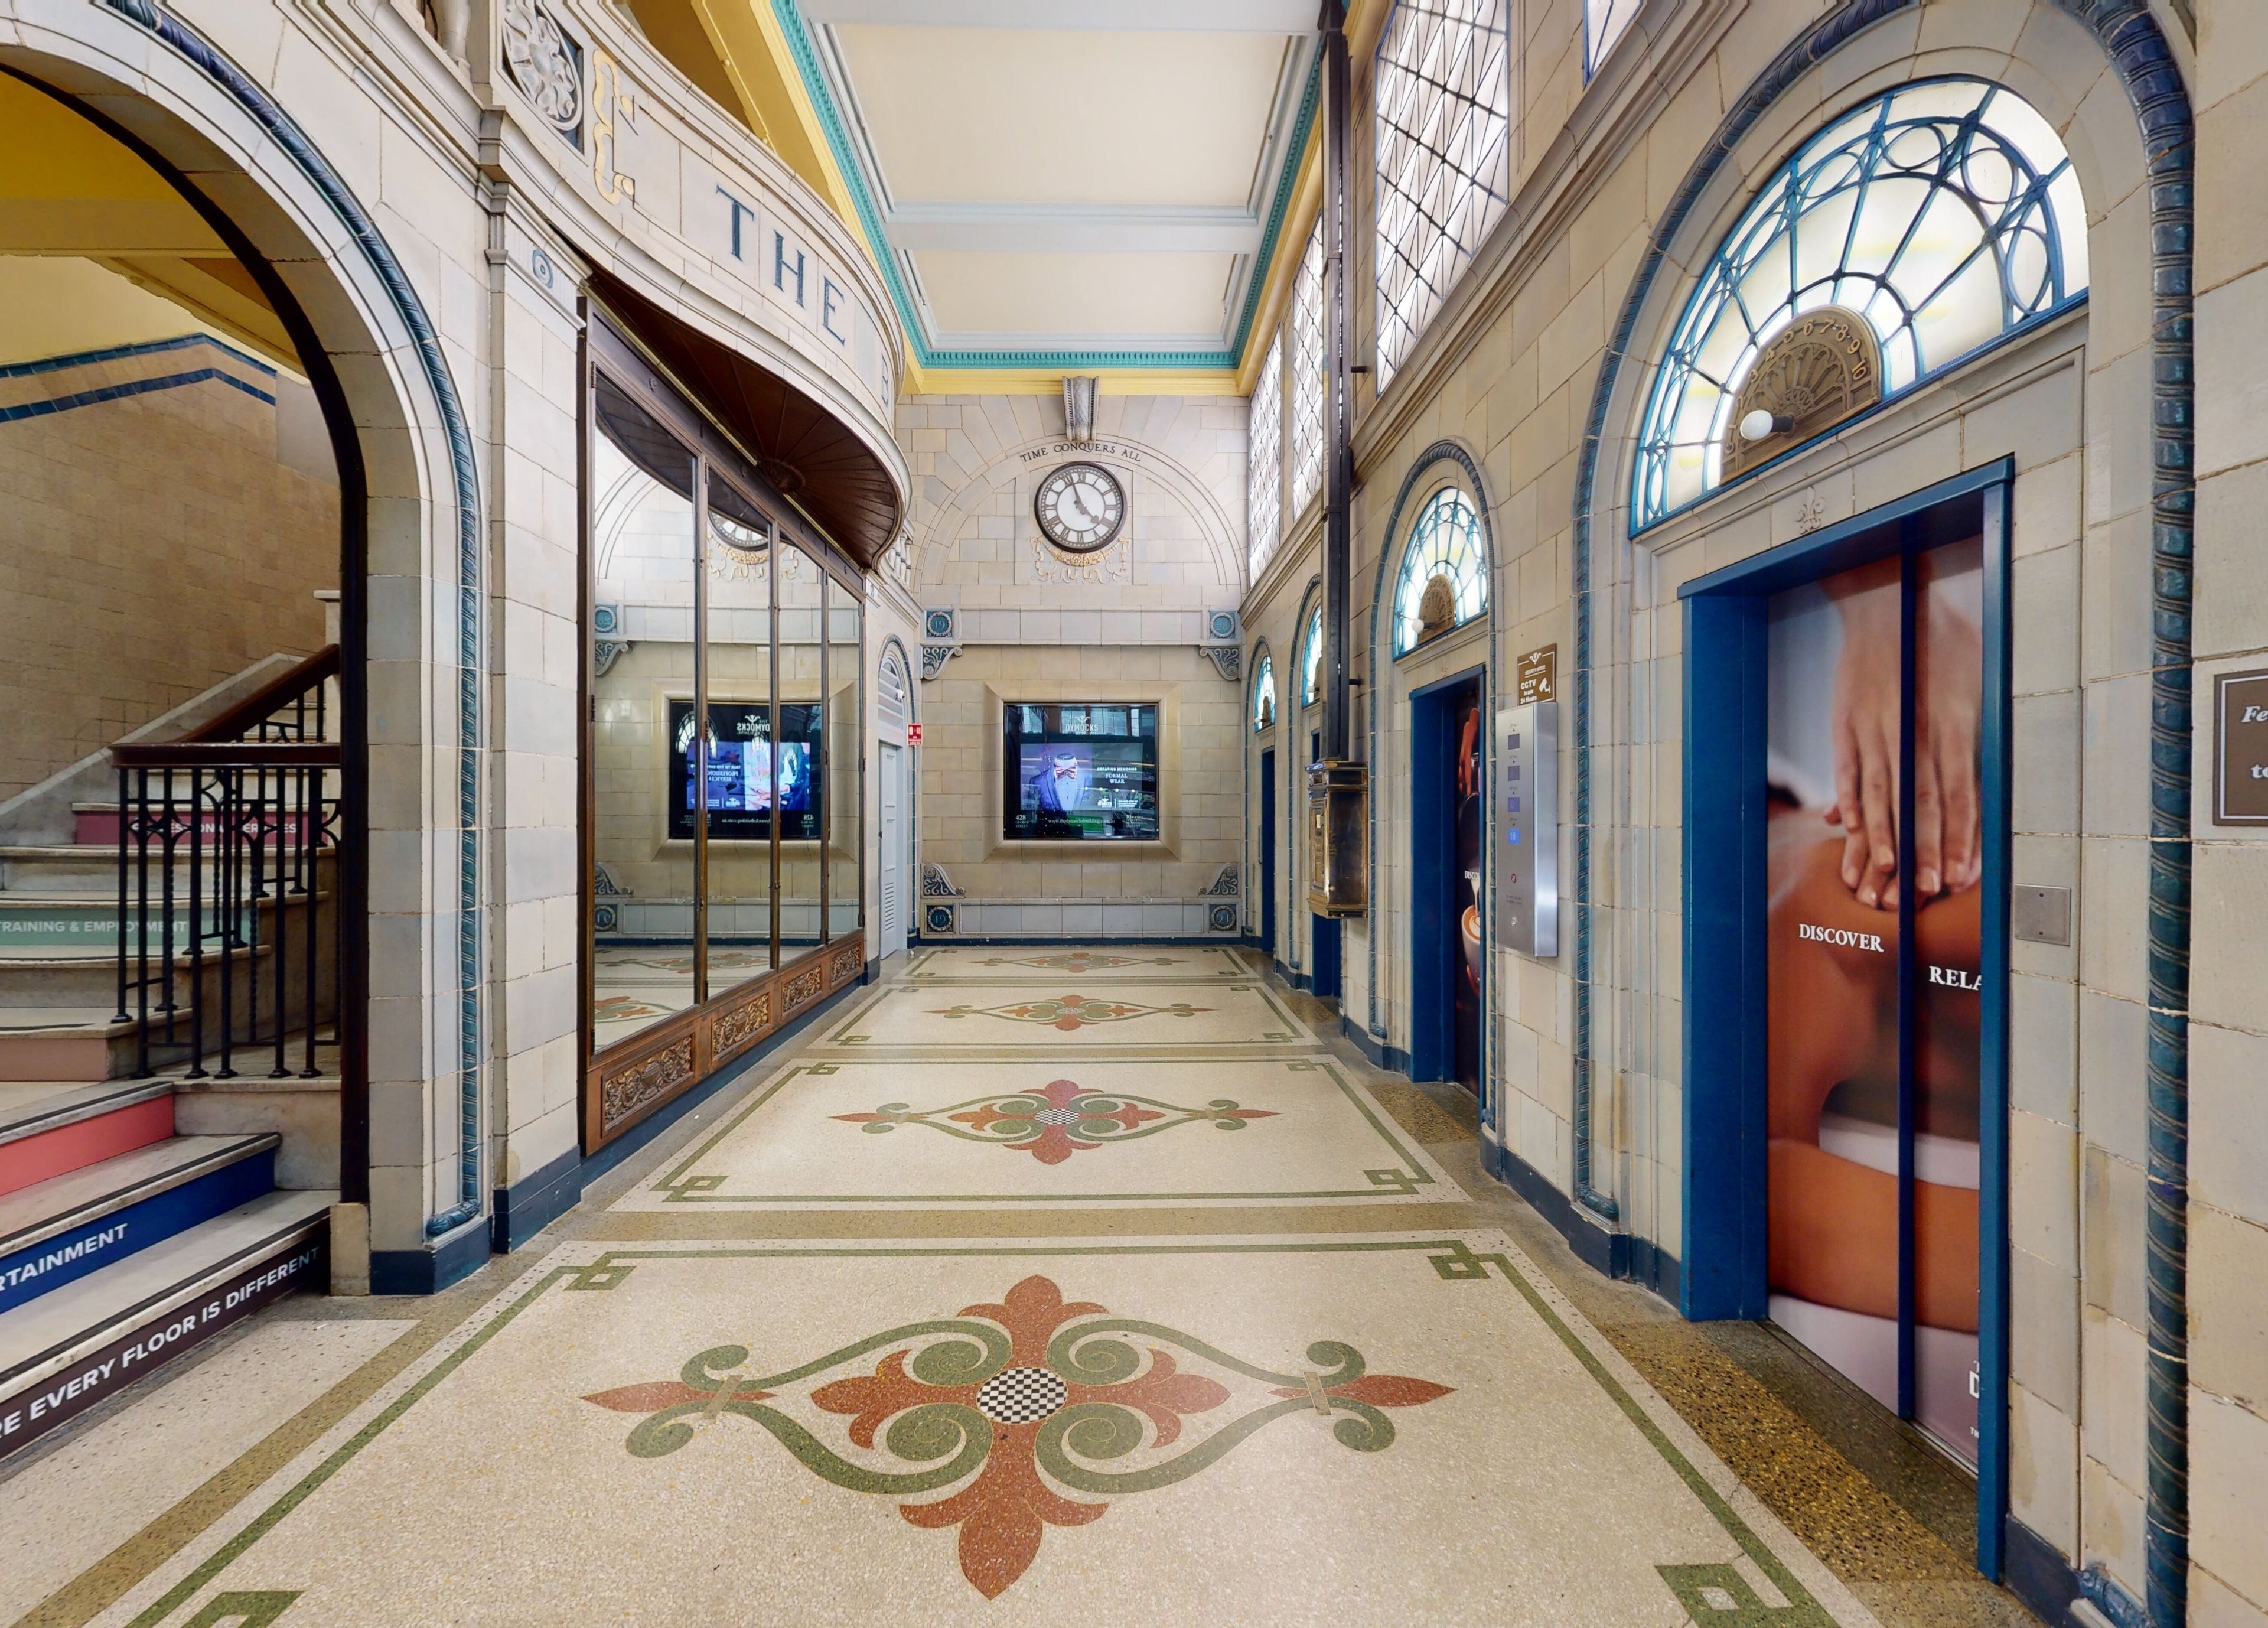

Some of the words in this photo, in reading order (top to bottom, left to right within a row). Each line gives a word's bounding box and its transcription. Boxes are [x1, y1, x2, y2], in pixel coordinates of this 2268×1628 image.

[716, 184, 845, 346] THE
[1020, 447, 1048, 462] TIME
[1054, 442, 1116, 454] CONQUERS
[1122, 449, 1140, 461] ALL
[935, 620, 946, 629] 19
[1521, 679, 1536, 689] CCTV
[0, 920, 65, 932] RAINING
[70, 921, 79, 932] &
[936, 914, 946, 924] 19
[1799, 924, 1884, 952] DISCOVER
[30, 1357, 116, 1421] EVERY
[122, 1315, 196, 1369] FLOOR
[201, 1302, 220, 1323] IS
[225, 1246, 320, 1310] DIFFERENT
